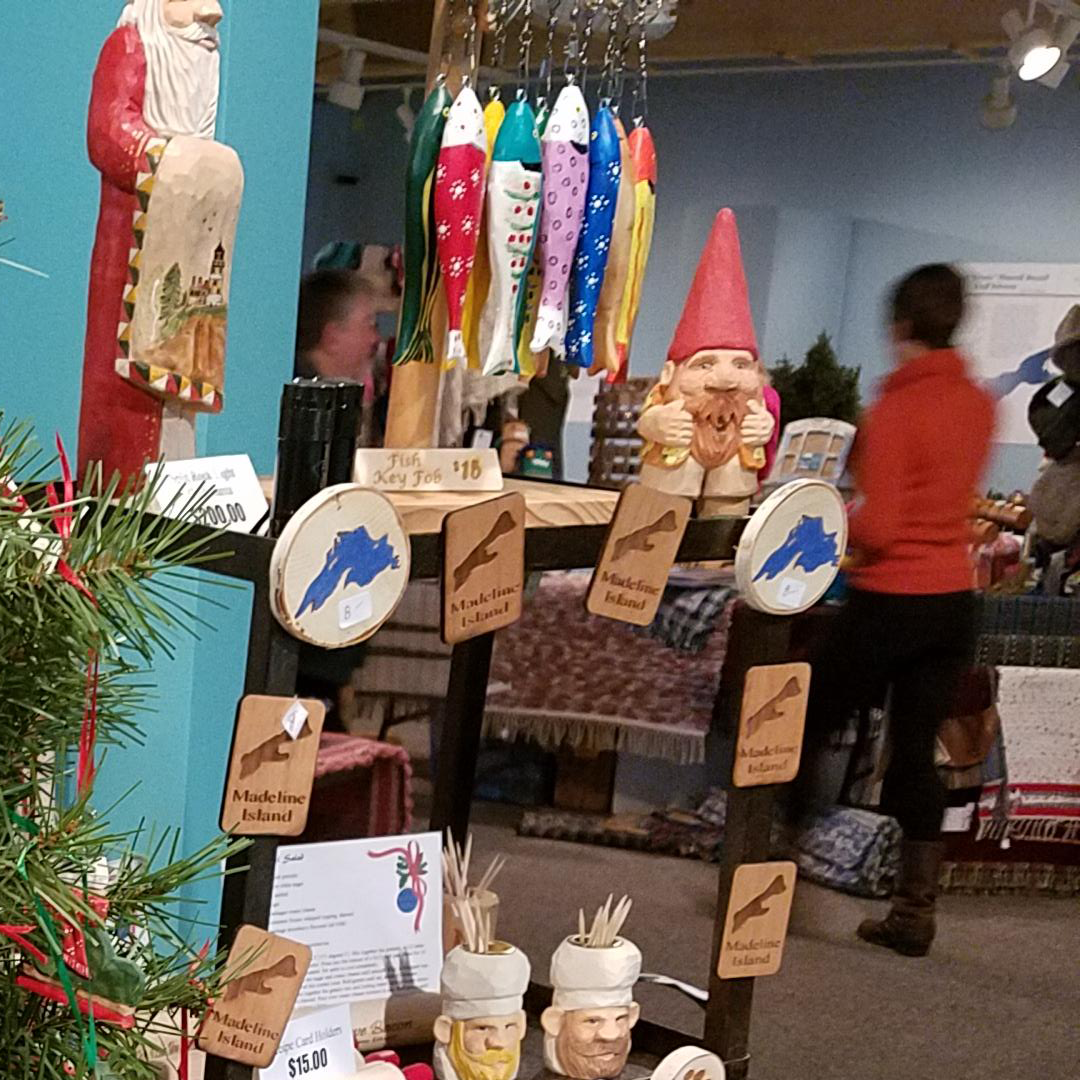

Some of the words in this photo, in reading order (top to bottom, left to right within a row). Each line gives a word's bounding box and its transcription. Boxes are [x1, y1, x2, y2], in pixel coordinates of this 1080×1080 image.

[387, 453, 420, 479] Fish
[373, 472, 408, 490] Key
[413, 471, 443, 486] Fob
[600, 570, 660, 596] Madeline
[450, 583, 520, 615] Madeline
[604, 590, 646, 611] Island
[461, 602, 509, 628] Island
[739, 743, 797, 758] Madeline
[747, 760, 787, 775] Island
[232, 789, 307, 805] Madeline
[241, 808, 293, 823] Island
[726, 939, 782, 952] Madeline
[732, 954, 771, 967] Island
[212, 1010, 280, 1041] Madeline
[217, 1030, 265, 1054] Island
[295, 1031, 314, 1047] Card
[287, 1047, 328, 1079] $15.00
